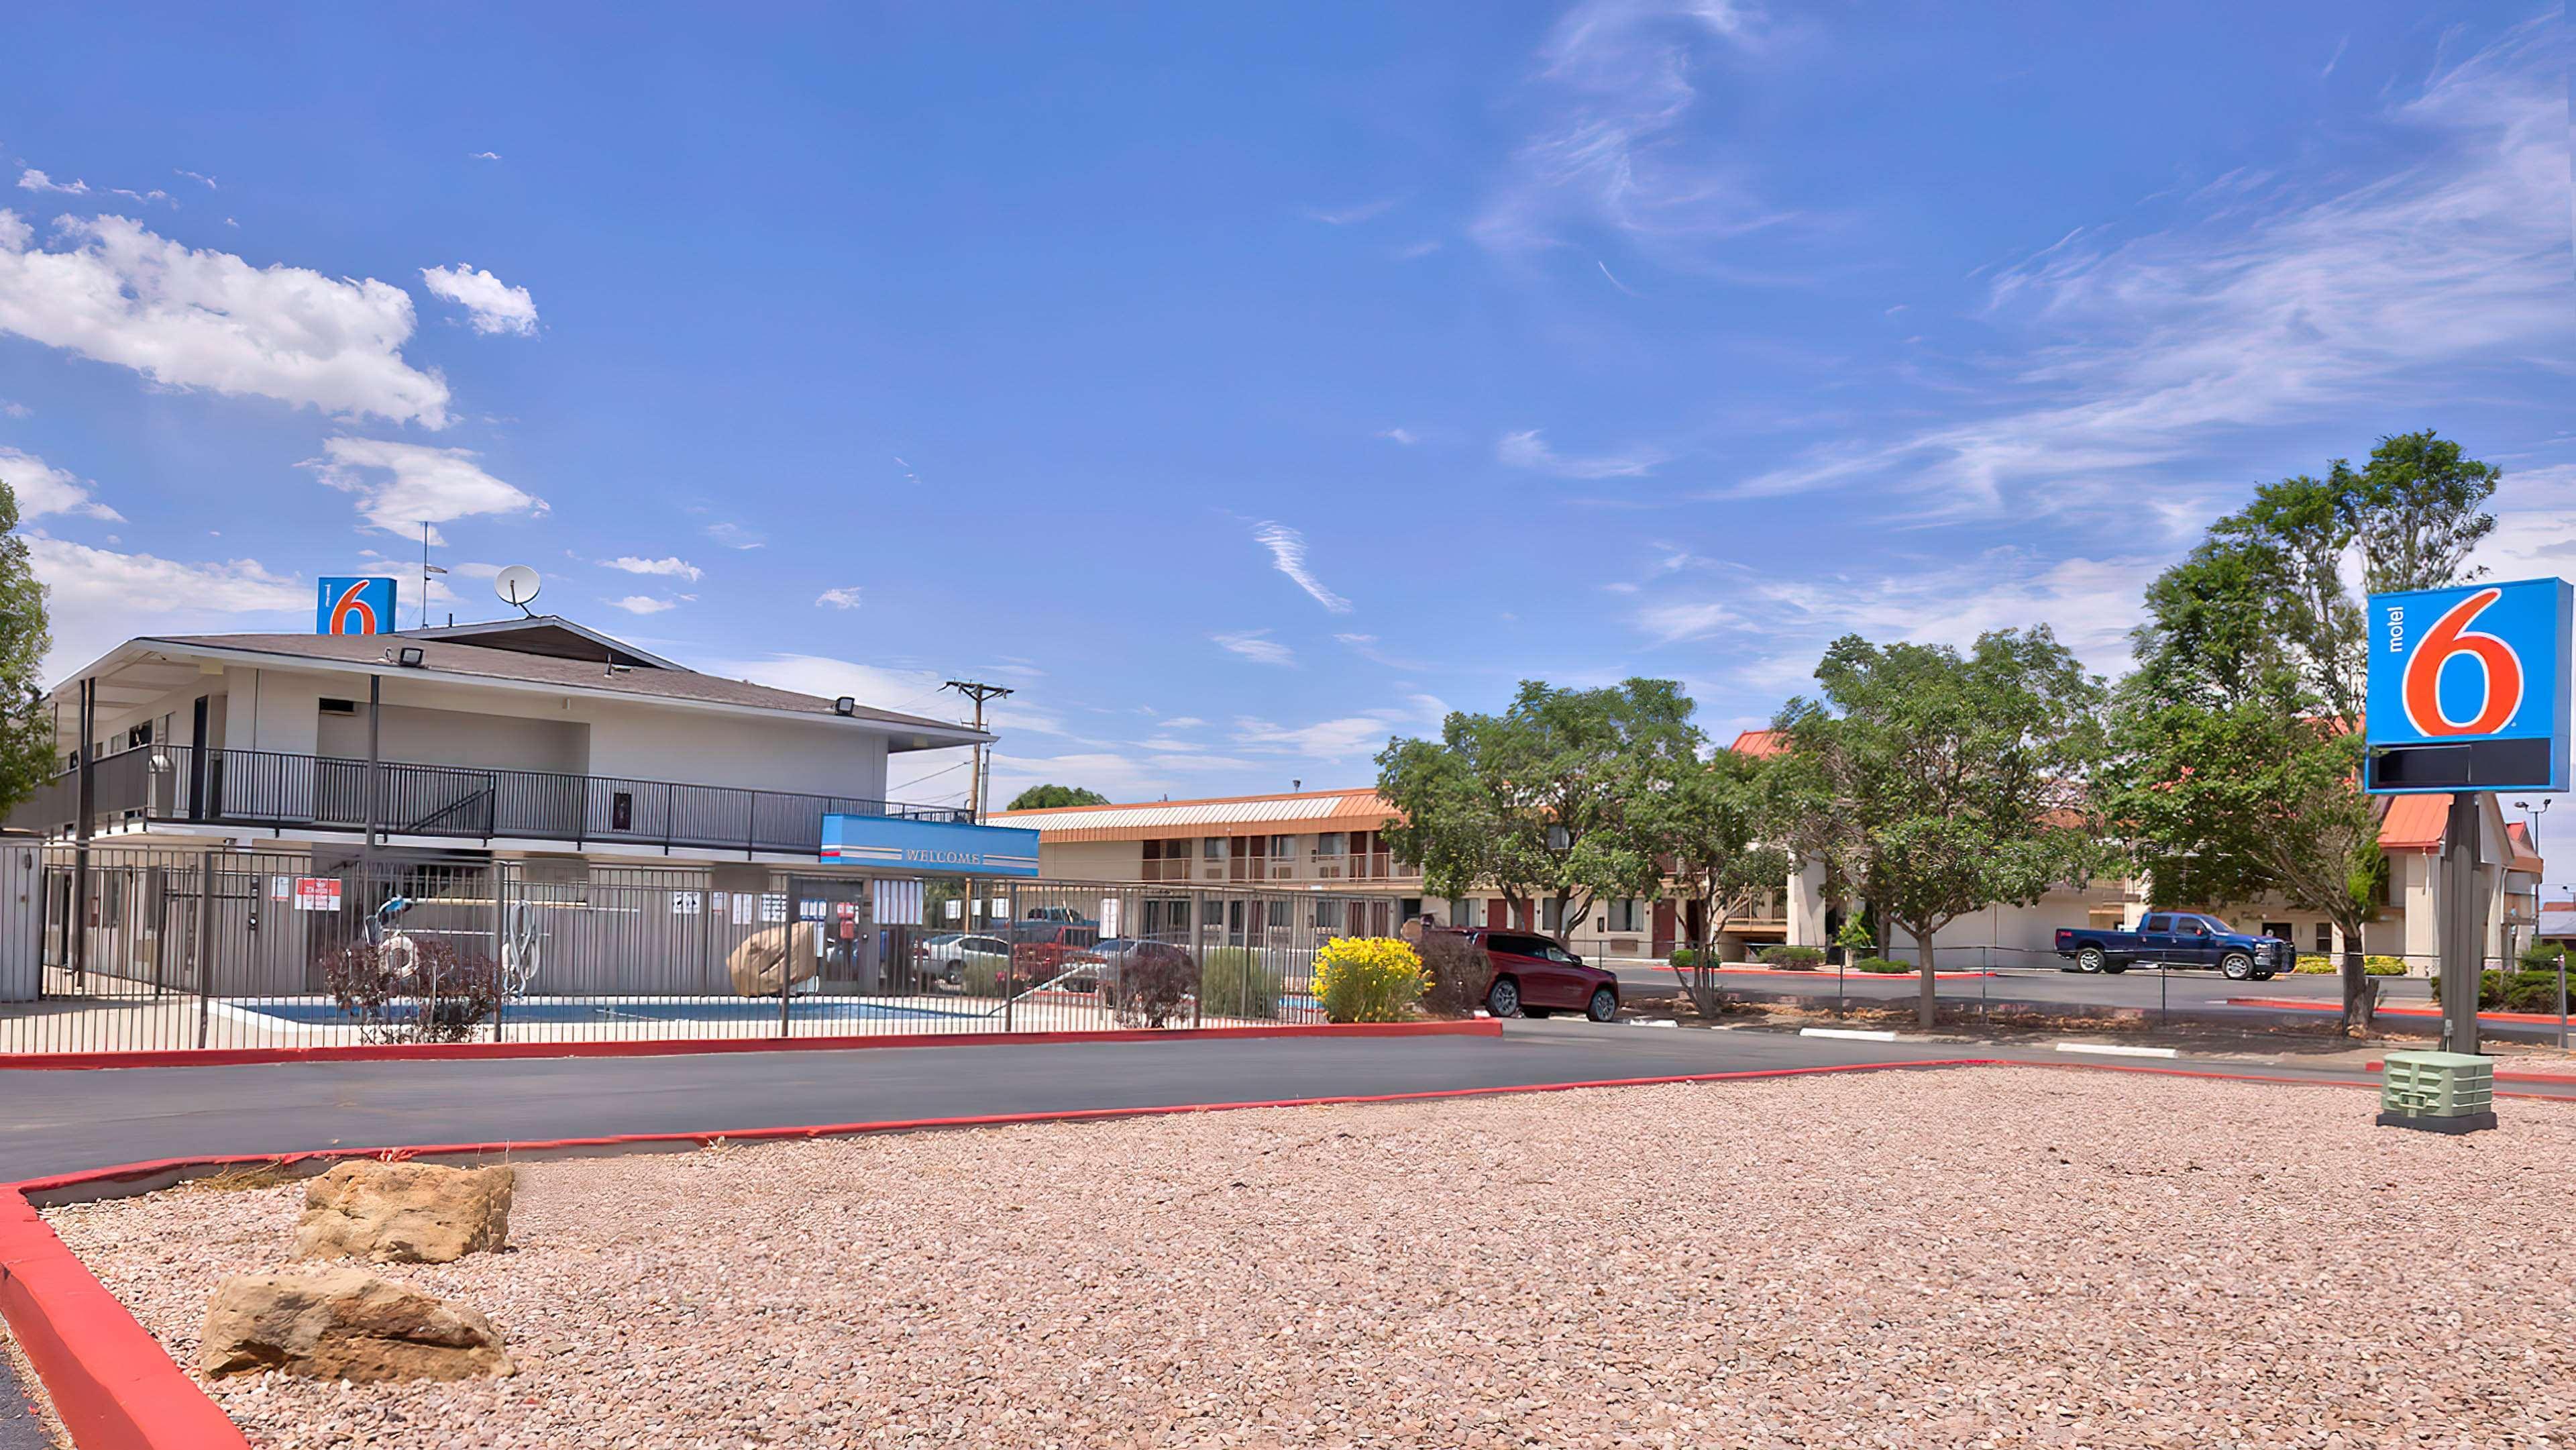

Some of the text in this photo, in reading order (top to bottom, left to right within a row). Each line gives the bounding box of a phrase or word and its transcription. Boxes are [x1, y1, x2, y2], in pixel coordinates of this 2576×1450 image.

[329, 579, 377, 635] 6
[2387, 607, 2404, 652] motel
[2402, 587, 2524, 737] 6
[906, 849, 980, 865] WELCOME
